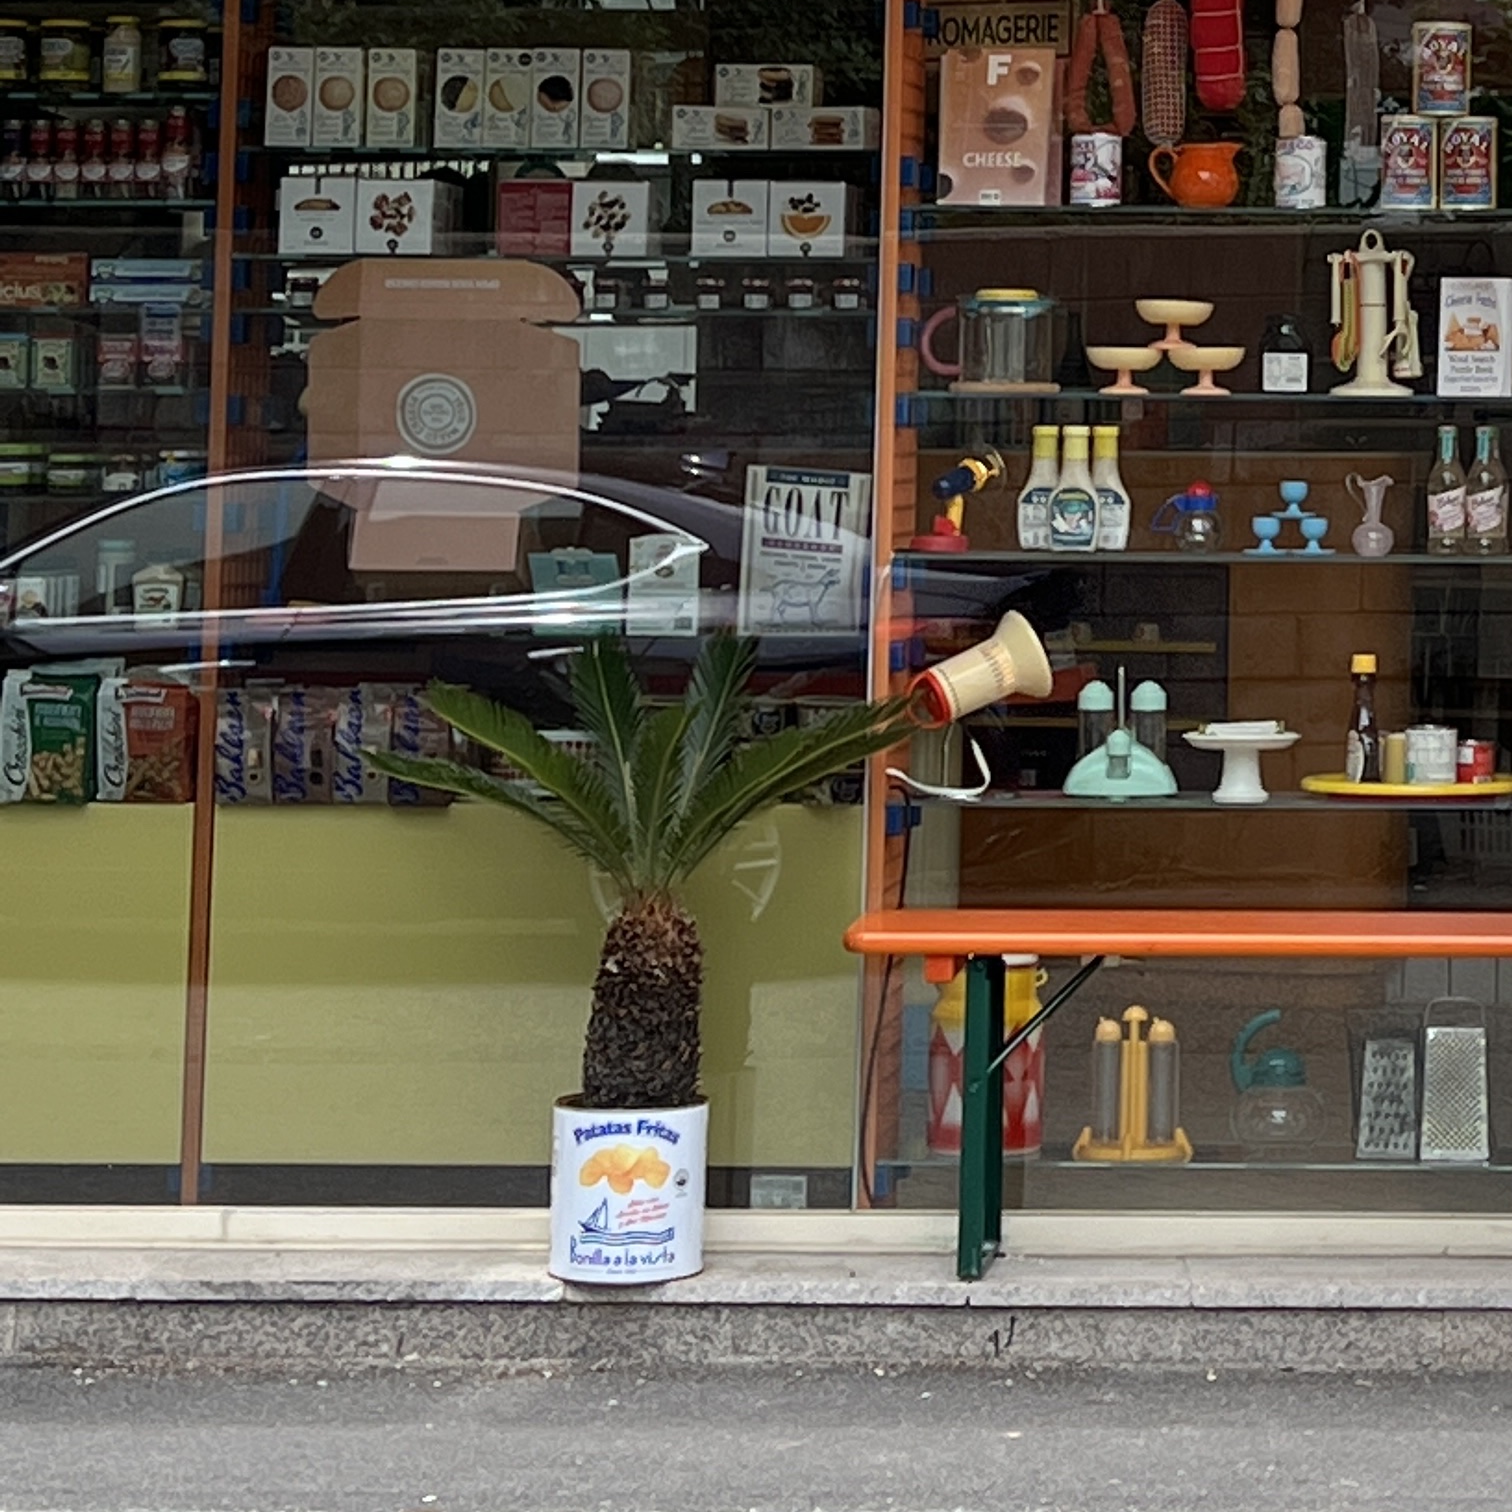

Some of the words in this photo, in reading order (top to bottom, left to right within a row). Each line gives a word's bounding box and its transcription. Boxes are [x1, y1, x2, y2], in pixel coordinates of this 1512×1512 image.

[986, 54, 1013, 86] F
[962, 151, 1022, 169] CHEESE
[763, 485, 850, 540] GOAT
[573, 1122, 632, 1146] Patatas
[636, 1119, 681, 1145] Fritas
[569, 1234, 611, 1265] Bonilla
[612, 1255, 622, 1267] a
[624, 1248, 638, 1265] la
[640, 1246, 676, 1265] vista
